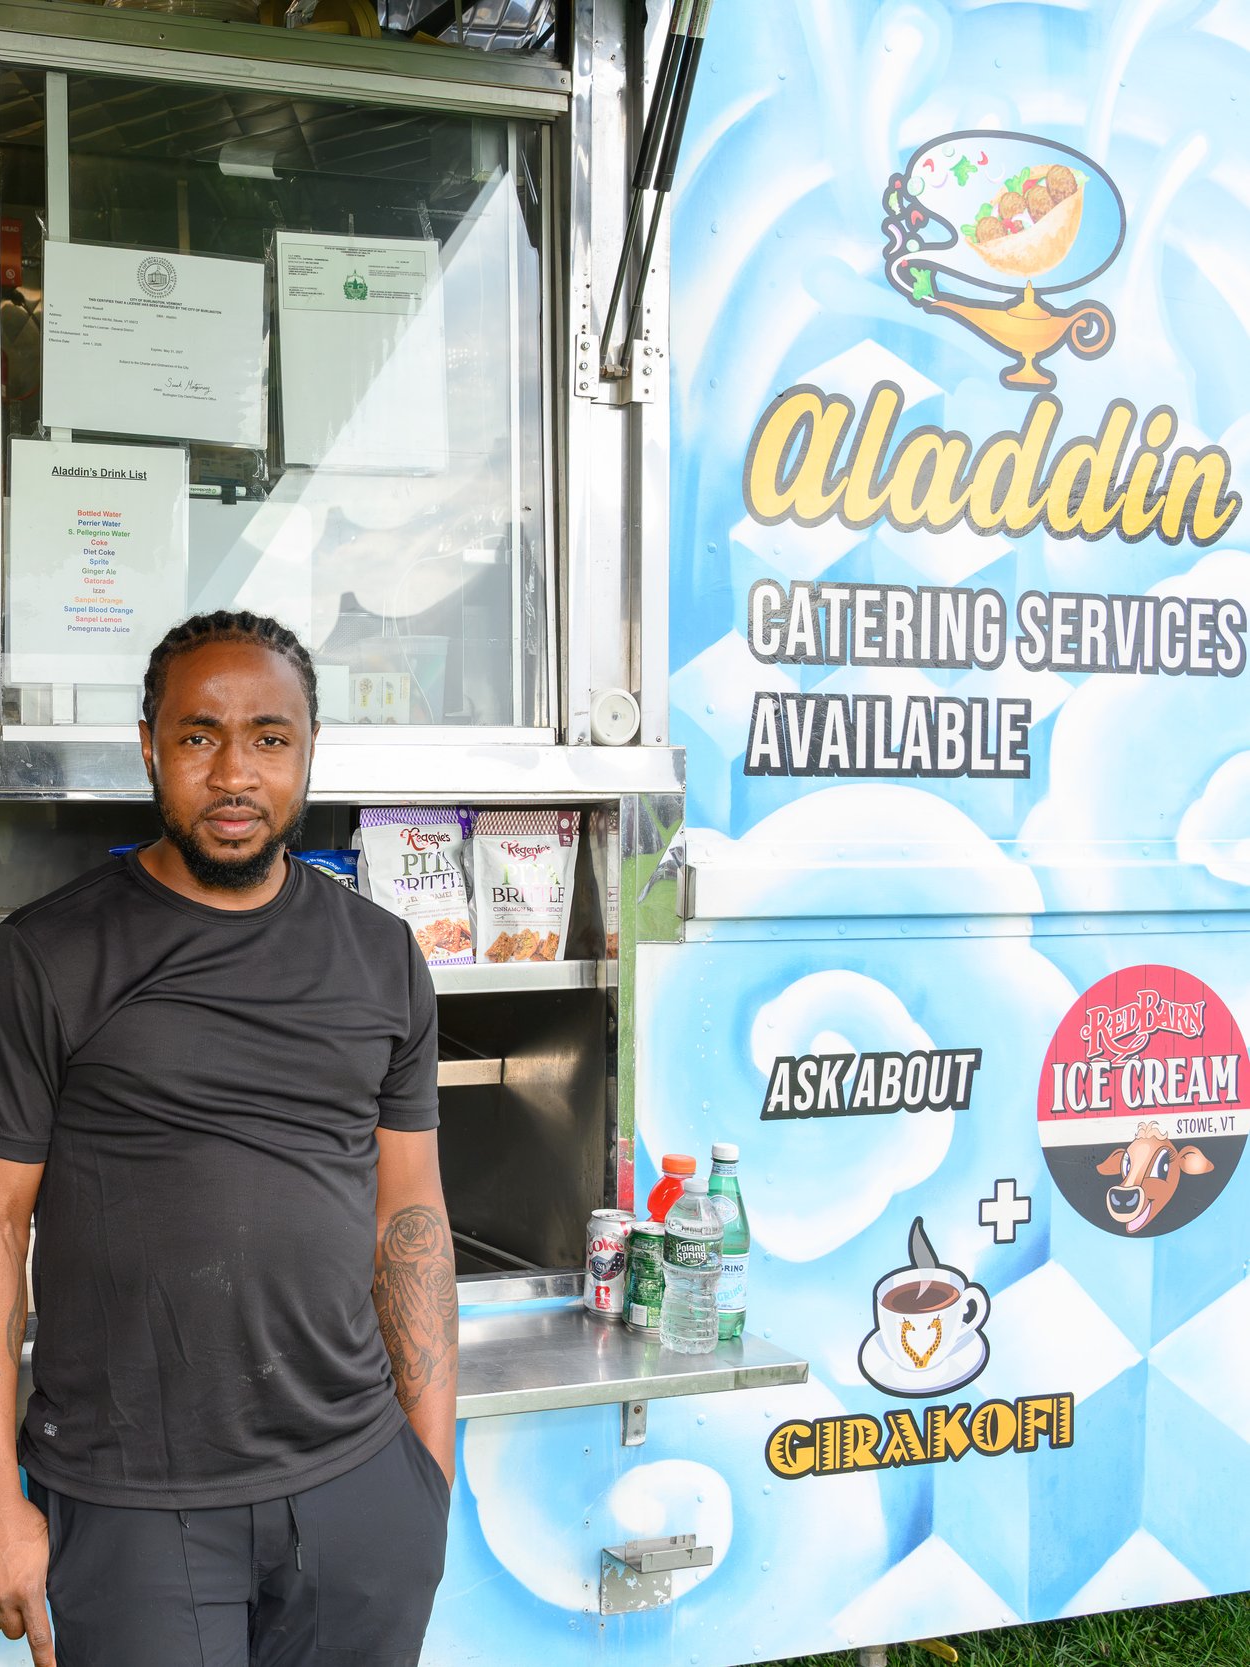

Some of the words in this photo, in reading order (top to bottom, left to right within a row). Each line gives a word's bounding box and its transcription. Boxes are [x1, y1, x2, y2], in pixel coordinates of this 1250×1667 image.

[52, 466, 98, 478] Aladdin's
[100, 468, 126, 479] Drink
[129, 470, 148, 480] List
[77, 529, 110, 537] Pellegrino
[110, 607, 133, 615] Orange
[68, 625, 111, 633] Pomegranate
[748, 579, 1007, 671] CATERING
[1016, 590, 1247, 677] SERVICES
[744, 692, 1031, 778] AVAILABLE
[402, 852, 455, 876] PITA
[1080, 1001, 1149, 1060] RED
[1137, 989, 1206, 1037] BARN
[764, 1056, 853, 1117] ASK
[851, 1049, 981, 1113] ABOUT
[1051, 1059, 1112, 1113] ICE
[1121, 1054, 1241, 1109] CREAM
[1176, 1118, 1217, 1135] STOWE,
[1220, 1116, 1236, 1132] VT
[588, 1237, 624, 1255] Coke
[676, 1241, 706, 1252] Poland
[676, 1251, 707, 1262] Spring
[766, 1392, 1074, 1479] GIRAKOFI
